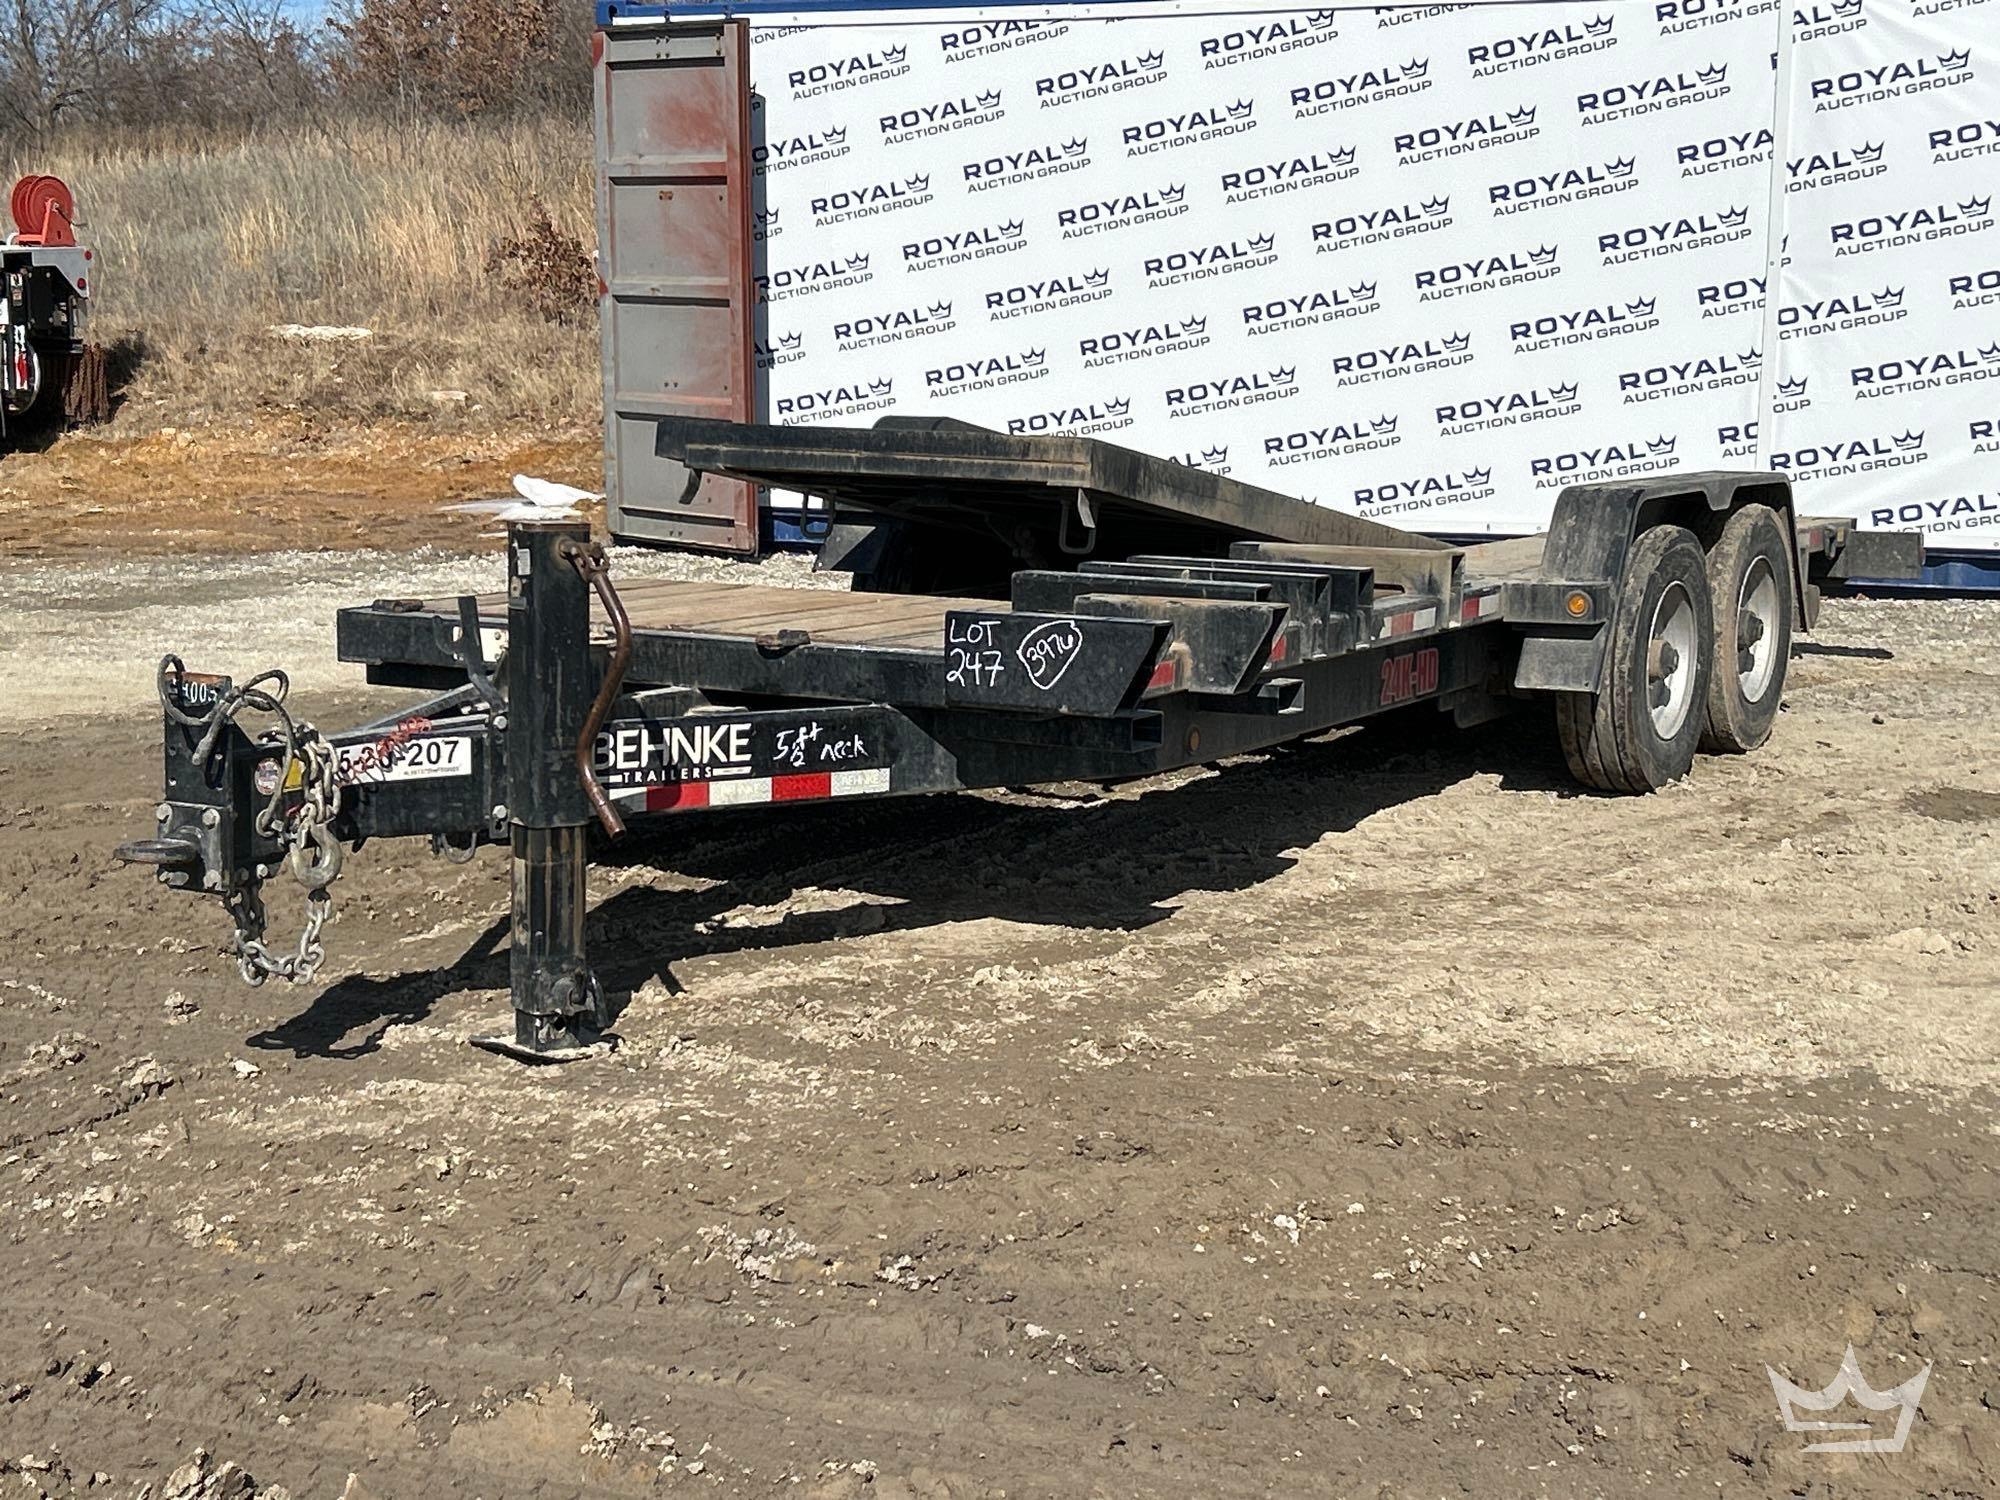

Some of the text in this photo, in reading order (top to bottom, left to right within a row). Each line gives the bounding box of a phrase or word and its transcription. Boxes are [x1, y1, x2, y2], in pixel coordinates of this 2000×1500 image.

[1378, 4, 1453, 28] AUCTION
[1660, 9, 1742, 36] AUCTION
[1747, 0, 1780, 20] GRO
[1801, 19, 1867, 41] GROUP
[941, 20, 1039, 50] ROYAL
[946, 26, 1069, 64] AUCTION GROUP
[1200, 19, 1307, 57] ROYAL
[1205, 31, 1338, 70] AUCTION GROUP
[1468, 25, 1584, 65] ROYAL
[788, 53, 883, 88] ROYAL
[1472, 38, 1617, 79] AUCTION GROUP
[793, 65, 910, 100] AUCTION GROUP
[1036, 60, 1138, 96] ROYAL
[1040, 71, 1167, 109] AUCTION GROUP
[1290, 68, 1400, 106] ROYAL
[1577, 73, 1696, 113] ROYAL
[1811, 59, 1937, 99] ROYAL
[1815, 72, 1974, 113] AUCTION GROUP
[879, 98, 976, 133] ROYAL
[1295, 80, 1432, 119] AUCTION GROUP
[1581, 86, 1731, 127] AUCTION GROUP
[884, 110, 1005, 146] AUCTION GROUP
[1122, 108, 1227, 144] ROYAL
[1127, 120, 1257, 157] AUCTION GROUP
[1394, 115, 1507, 153] ROYAL
[1929, 120, 2000, 149] ROY
[752, 135, 823, 162] OYAL
[754, 146, 850, 177] CTION GROUP
[1399, 128, 1540, 167] AUCTION GROUP
[1677, 129, 1774, 164] ROYA
[1934, 142, 2000, 164] AUCTIO
[963, 146, 1062, 181] ROYAL
[968, 158, 1091, 193] AUCTION GROUP
[1221, 155, 1328, 191] ROYAL
[1682, 152, 1763, 178] AUCTION
[1786, 152, 1851, 177] YAL
[1821, 165, 1887, 186] GROUP
[811, 182, 906, 215] ROYAL
[1226, 167, 1359, 204] AUCTION GROUP
[1489, 166, 1605, 204] ROYAL
[1493, 179, 1639, 217] AUCTION GROUP
[816, 194, 933, 227] AUCTION GROUP
[1058, 192, 1159, 227] ROYAL
[1063, 205, 1189, 240] AUCTION GROUP
[1312, 205, 1421, 241] ROYAL
[1831, 205, 1958, 243] ROYAL
[754, 228, 782, 241] OUP
[902, 228, 999, 260] ROYAL
[1316, 218, 1453, 254] AUCTION GROUP
[1598, 215, 1717, 253] ROYAL
[1603, 228, 1752, 266] AUCTION GROUP
[1835, 219, 1994, 257] AUCTION GROUP
[907, 240, 1027, 273] AUCTION GROUP
[1144, 242, 1248, 276] ROYAL
[1149, 254, 1278, 289] AUCTION GROUP
[1415, 254, 1528, 289] ROYAL
[824, 273, 872, 290] GROUP
[985, 277, 1084, 309] ROYAL
[1419, 266, 1561, 302] AUCTION GROUP
[1698, 276, 1767, 305] ROY
[990, 289, 1112, 321] AUCTION GROUP
[1243, 290, 1349, 324] ROYAL
[1248, 302, 1380, 336] AUCTION GROUP
[1702, 298, 1766, 318] AUCTIO
[1778, 296, 1872, 325] OYAL
[834, 309, 928, 340] ROYAL
[839, 321, 956, 352] AUCTION GROUP
[1510, 305, 1626, 341] ROYAL
[1514, 319, 1659, 354] AUCTION GROUP
[1779, 310, 1907, 340] CTION GROUP
[1080, 324, 1181, 356] ROYAL
[1084, 336, 1210, 369] AUCTION GROUP
[925, 355, 1021, 386] ROYAL
[1333, 340, 1442, 374] ROYAL
[1337, 354, 1474, 387] AUCTION GROUP
[1619, 356, 1738, 391] ROYAL
[1851, 351, 1978, 386] ROYAL
[930, 368, 1049, 398] AUCTION GROUP
[1165, 374, 1269, 406] ROYAL
[1624, 372, 1758, 404] AUCTION GROU
[1856, 368, 2000, 400] AUCTION GROU
[777, 385, 869, 415] ROYAL
[782, 398, 896, 427] AUCTION GROUP
[1170, 387, 1299, 418] AUCTION GROUP
[1435, 390, 1549, 424] ROYAL
[1773, 400, 1810, 413] OUP
[1008, 405, 1105, 435] ROYAL
[1081, 418, 1134, 434] GROUP
[1440, 404, 1581, 437] AUCTION GROUP
[1264, 423, 1370, 454] ROYAL
[1269, 436, 1401, 467] AUCTION GROUP
[1770, 438, 1892, 471] ROYAL
[1531, 443, 1646, 476] ROYAL
[1536, 457, 1680, 489] AUCTION GROUP
[1790, 453, 1928, 482] UCTION GROUP
[1354, 474, 1463, 506] ROYAL
[1359, 488, 1495, 517] AUCTION GROUP
[1871, 494, 1998, 527] ROYAL
[1966, 514, 2000, 527] GRO
[950, 619, 1001, 646] LOT
[946, 648, 1004, 687] 247
[593, 723, 752, 770] BEHNKE
[820, 734, 869, 761] neck
[623, 766, 713, 784] TRAILERS
